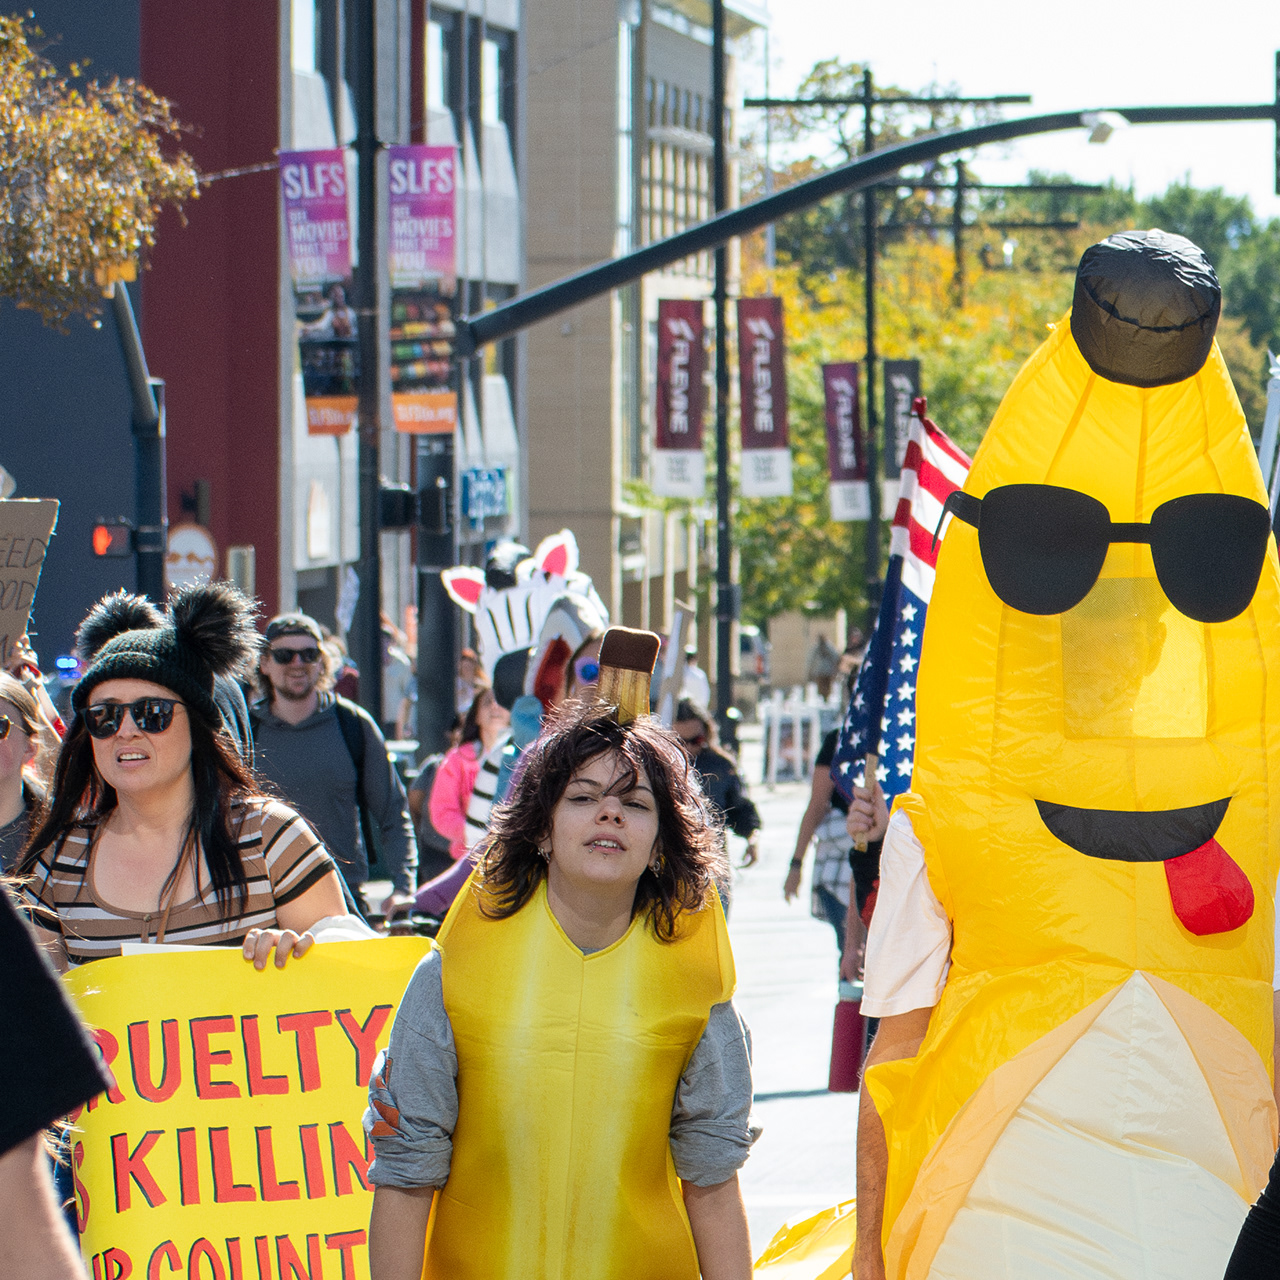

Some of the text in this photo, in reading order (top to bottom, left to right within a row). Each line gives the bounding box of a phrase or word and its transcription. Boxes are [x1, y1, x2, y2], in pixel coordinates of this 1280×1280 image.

[282, 162, 345, 199] SLFS
[389, 158, 453, 194] SLFS
[291, 221, 348, 242] MOVIES
[393, 218, 453, 238] MOVIES
[294, 255, 328, 275] YOU
[394, 252, 427, 270] YOU
[70, 1004, 394, 1124] RUELTY
